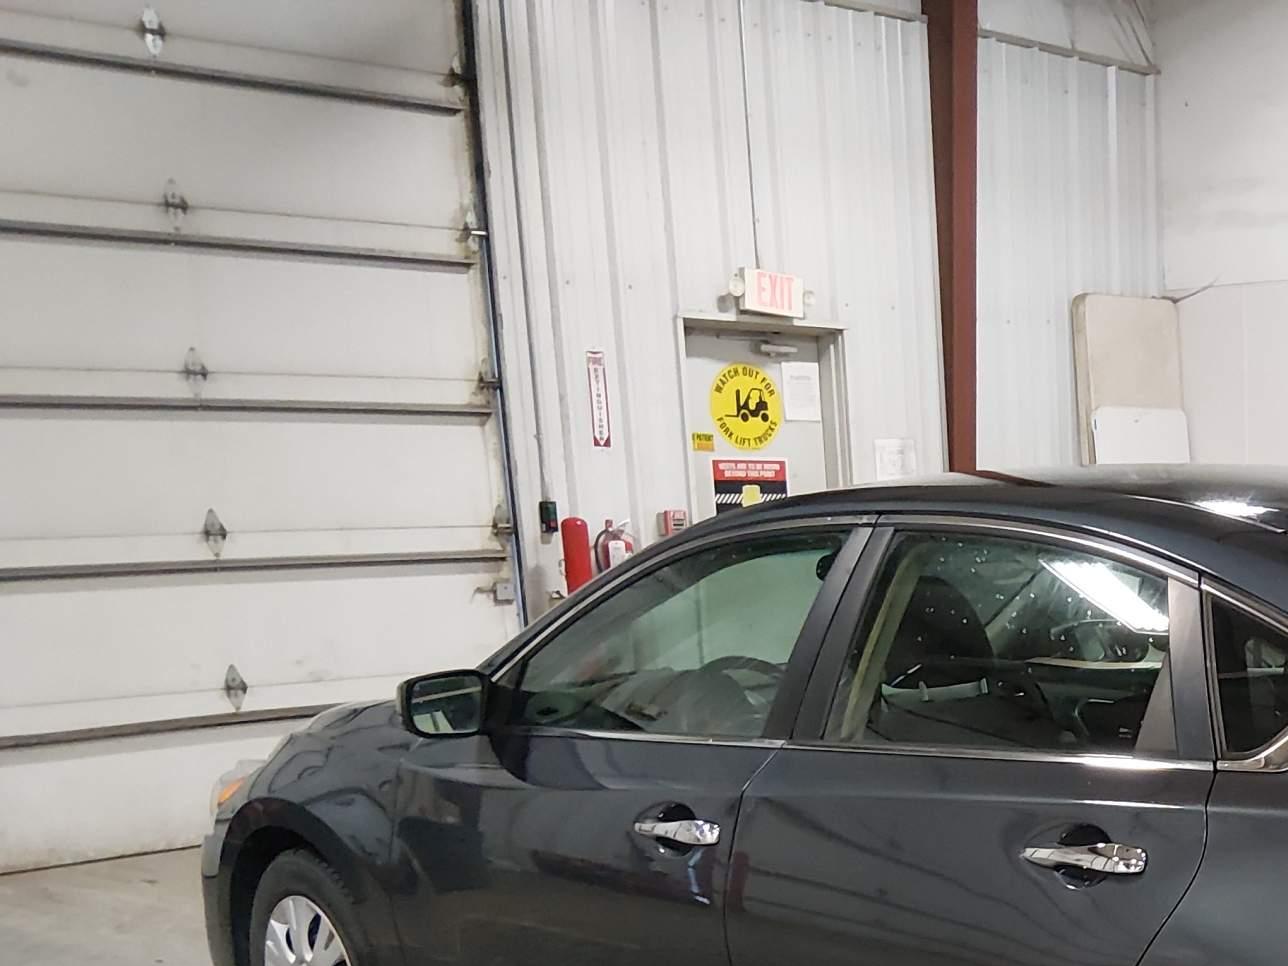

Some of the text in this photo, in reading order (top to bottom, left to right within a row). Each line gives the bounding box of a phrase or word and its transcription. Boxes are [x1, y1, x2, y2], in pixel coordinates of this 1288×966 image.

[757, 271, 794, 311] EXIT
[714, 366, 776, 398] WATCH OUT FOR
[716, 416, 778, 448] FORK LIFT TRUCKS
